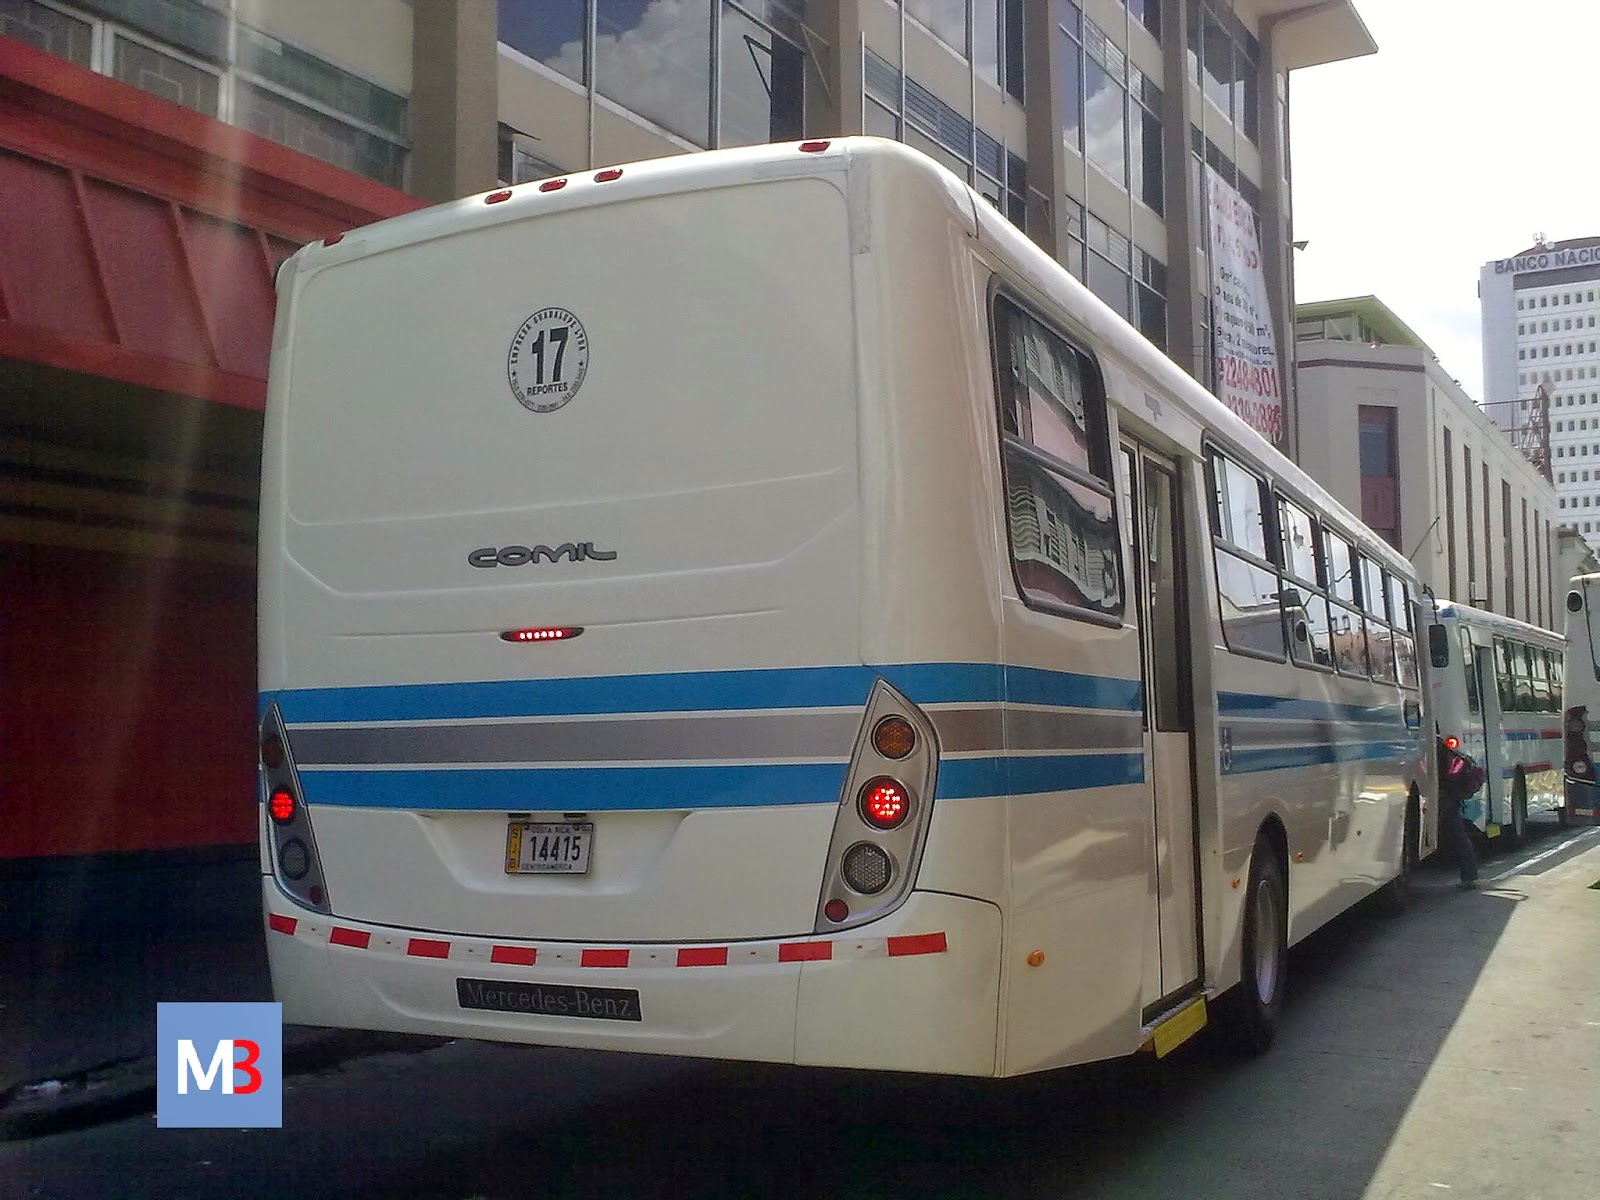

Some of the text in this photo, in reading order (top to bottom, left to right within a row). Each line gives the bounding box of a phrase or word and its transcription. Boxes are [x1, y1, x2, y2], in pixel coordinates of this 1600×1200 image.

[1495, 254, 1548, 274] BANCO
[511, 323, 532, 364] EMPRESA
[531, 326, 569, 385] 17
[526, 382, 569, 396] REPORTES
[531, 826, 551, 834] COSTA
[530, 835, 581, 861] 14415
[467, 982, 632, 1017] Mercedes-Benz
